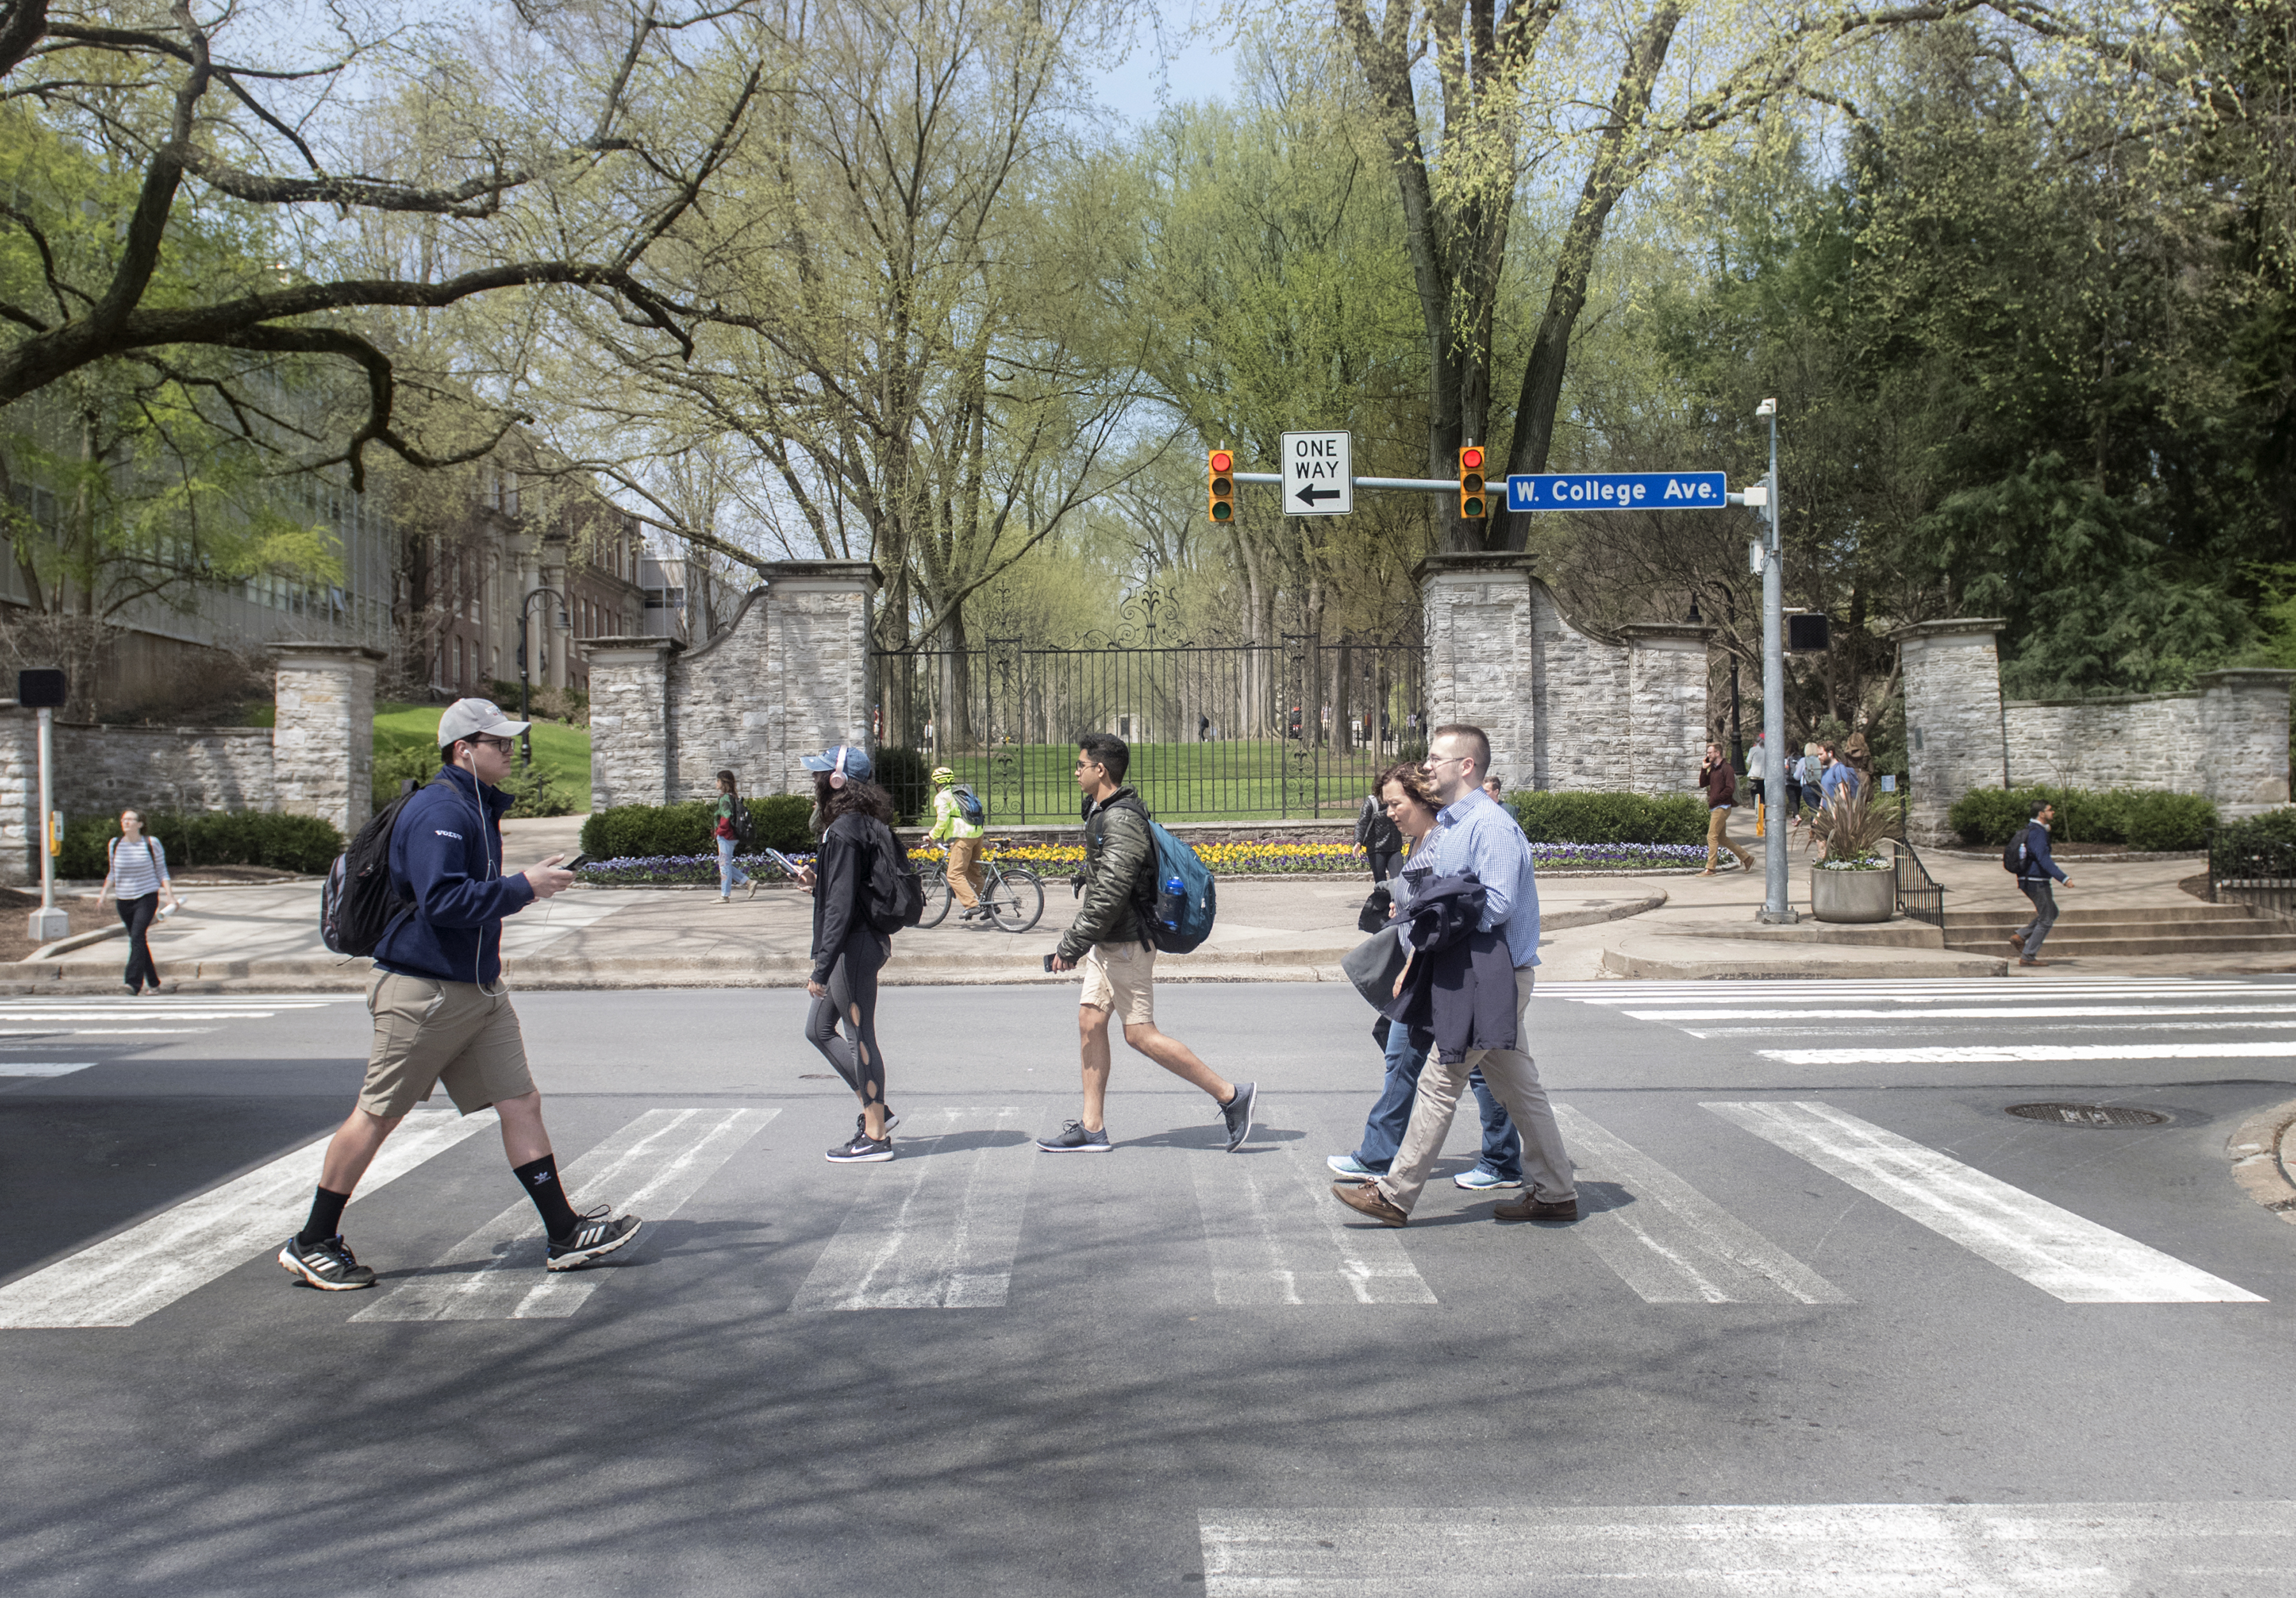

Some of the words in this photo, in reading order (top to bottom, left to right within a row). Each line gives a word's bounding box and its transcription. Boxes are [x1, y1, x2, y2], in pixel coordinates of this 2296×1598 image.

[1297, 439, 1337, 457] ONE
[1295, 461, 1339, 479] WAY
[1517, 481, 1540, 502] W.
[1552, 480, 1646, 506] College
[1663, 479, 1717, 499] Ave.
[434, 830, 462, 840] VOLVO
